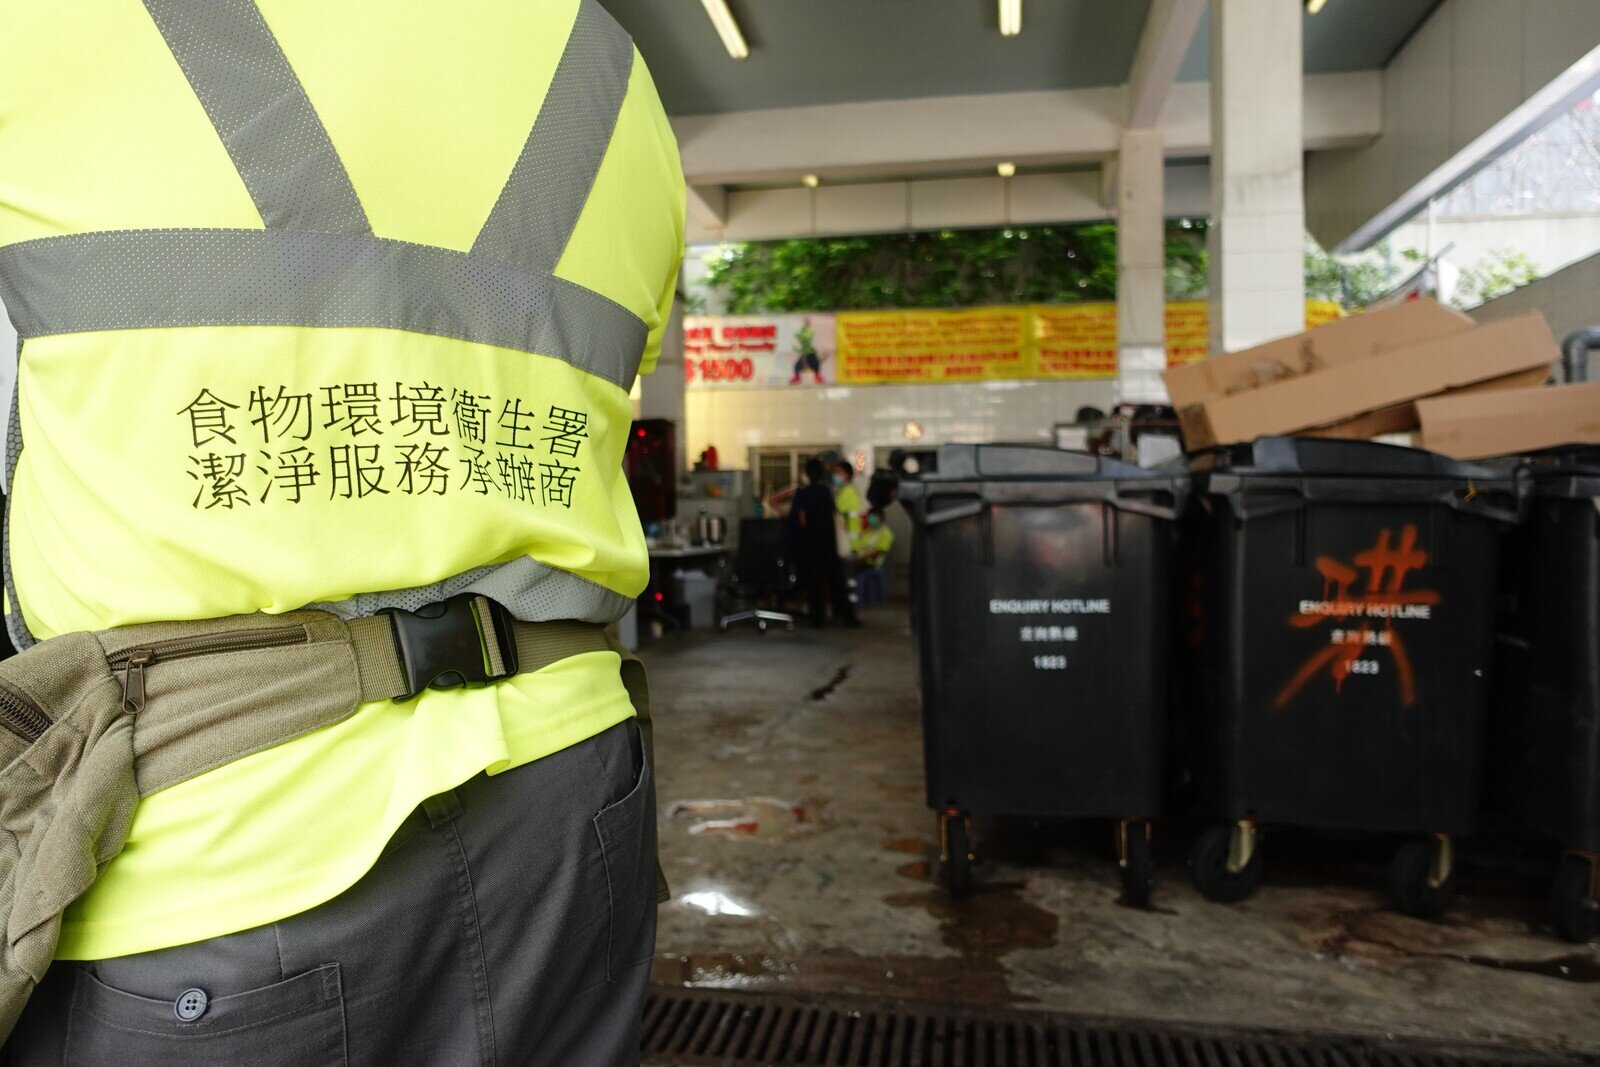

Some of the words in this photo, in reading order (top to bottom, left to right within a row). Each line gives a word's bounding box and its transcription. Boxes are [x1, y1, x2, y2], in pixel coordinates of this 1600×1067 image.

[186, 442, 581, 510] 潔淨服務承辦商
[989, 599, 1050, 614] ENQUIRY
[1051, 598, 1111, 613] HOTLINE
[1298, 600, 1365, 616] ENQUIRY
[1366, 603, 1431, 619] HOTLINE
[1033, 655, 1067, 669] 1823
[1344, 659, 1379, 675] 1823
